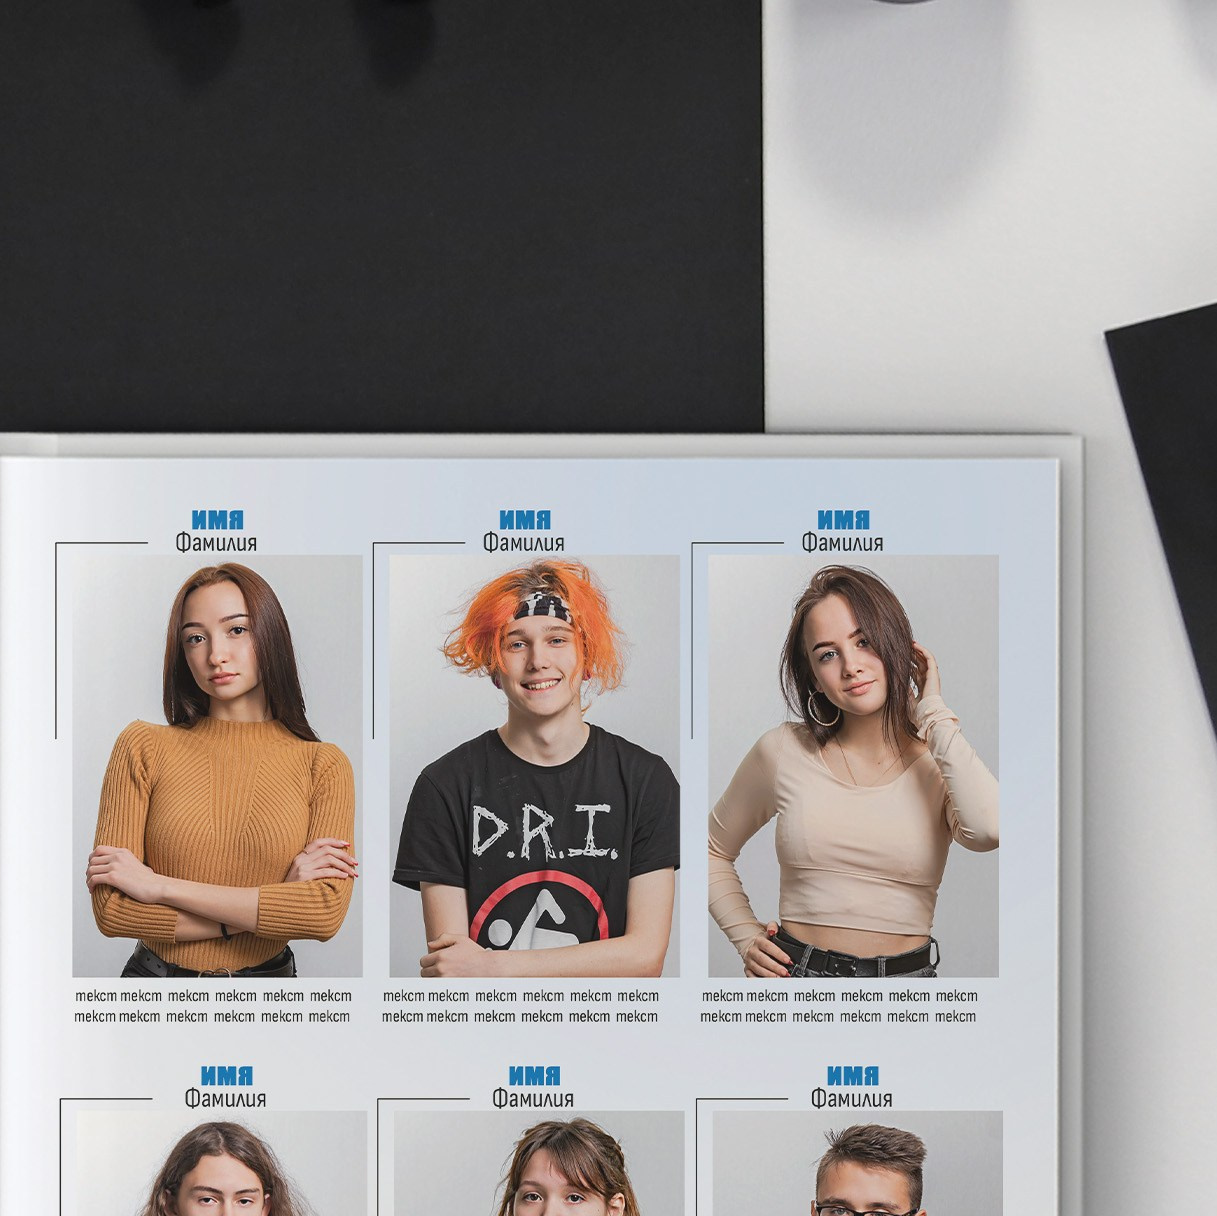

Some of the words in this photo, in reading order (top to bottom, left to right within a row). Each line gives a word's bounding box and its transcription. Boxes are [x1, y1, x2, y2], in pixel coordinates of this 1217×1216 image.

[192, 510, 244, 530] ИМЯ
[500, 510, 552, 530] ИМЯ
[818, 510, 870, 530] ИМЯ
[176, 531, 257, 553] Фамилия
[484, 531, 565, 553] Фамилия
[802, 531, 884, 553] Фамилия
[472, 803, 619, 862] D.R.I.
[201, 1066, 253, 1086] ИМЯ
[509, 1066, 561, 1086] ИМЯ
[827, 1066, 879, 1086] ИМЯ
[185, 1087, 266, 1109] Фамилия
[493, 1087, 574, 1109] Фамилия
[811, 1087, 893, 1109] Фамилия
